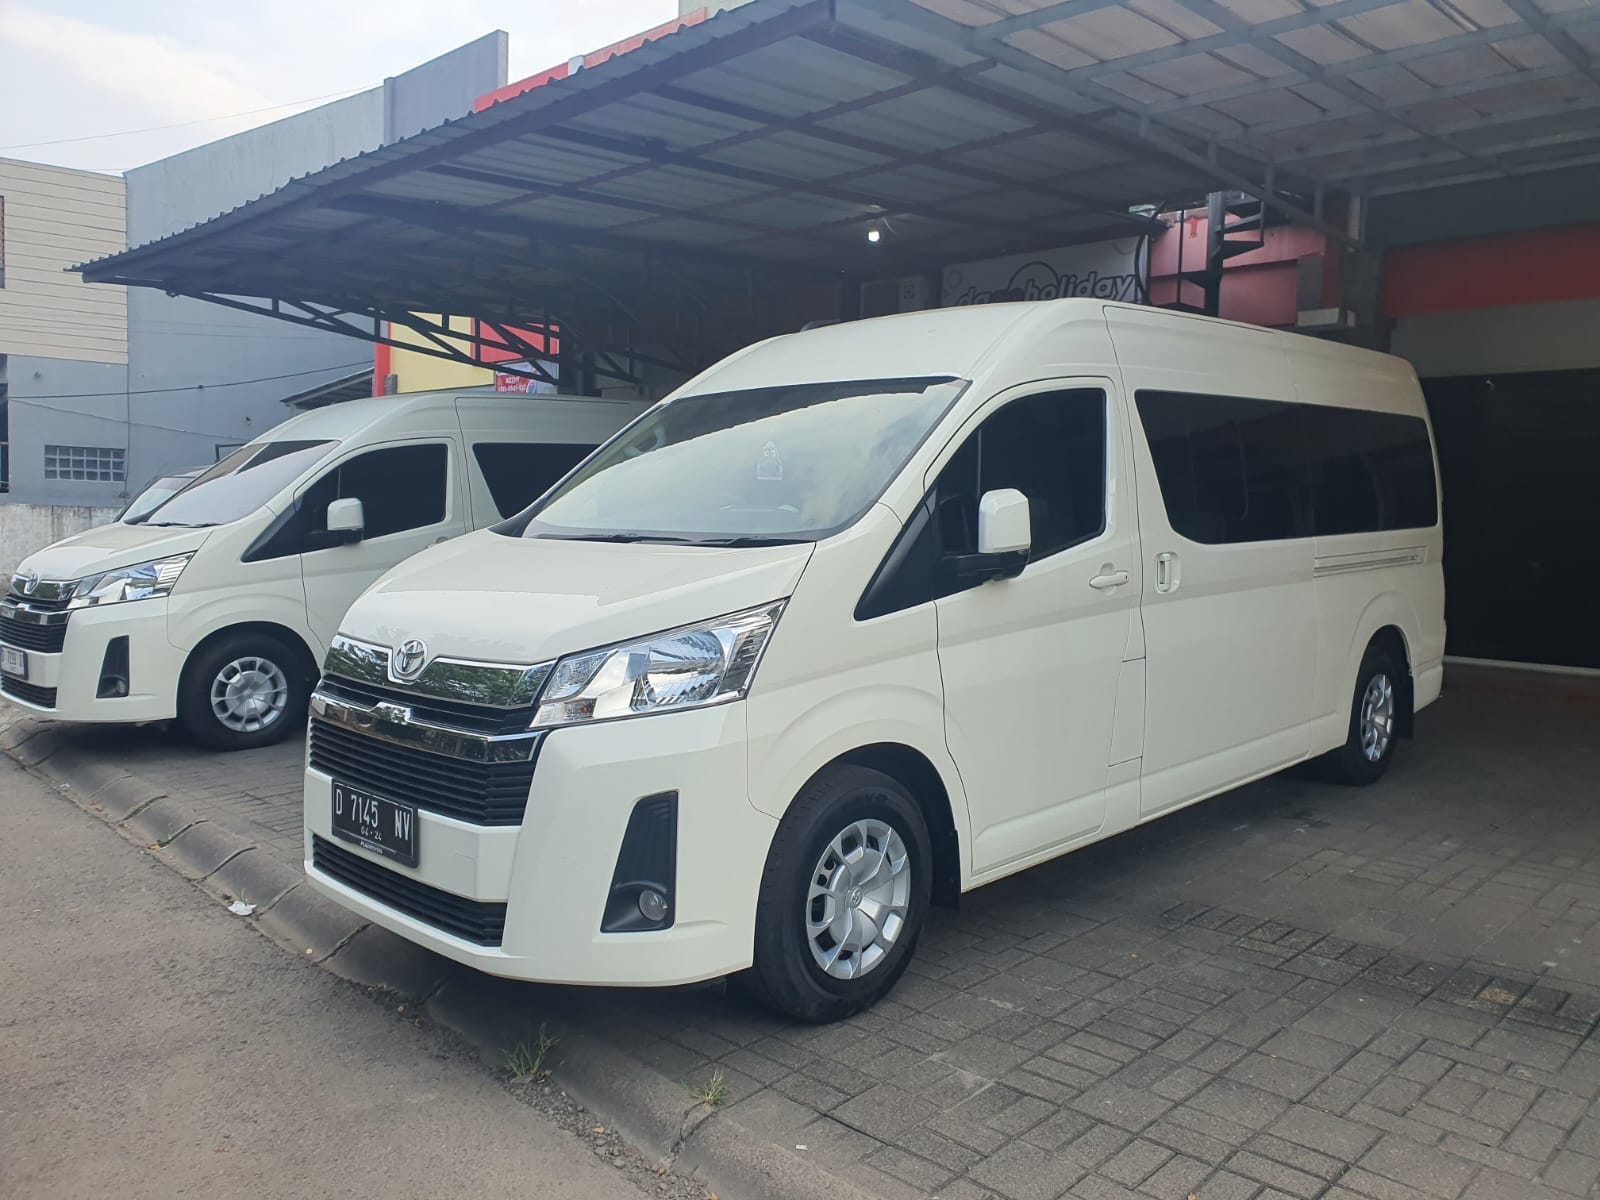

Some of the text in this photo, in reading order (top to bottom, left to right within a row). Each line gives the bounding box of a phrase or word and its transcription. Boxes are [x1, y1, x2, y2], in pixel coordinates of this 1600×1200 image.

[1024, 270, 1138, 303] holiday
[335, 788, 411, 841] D 7145 NV
